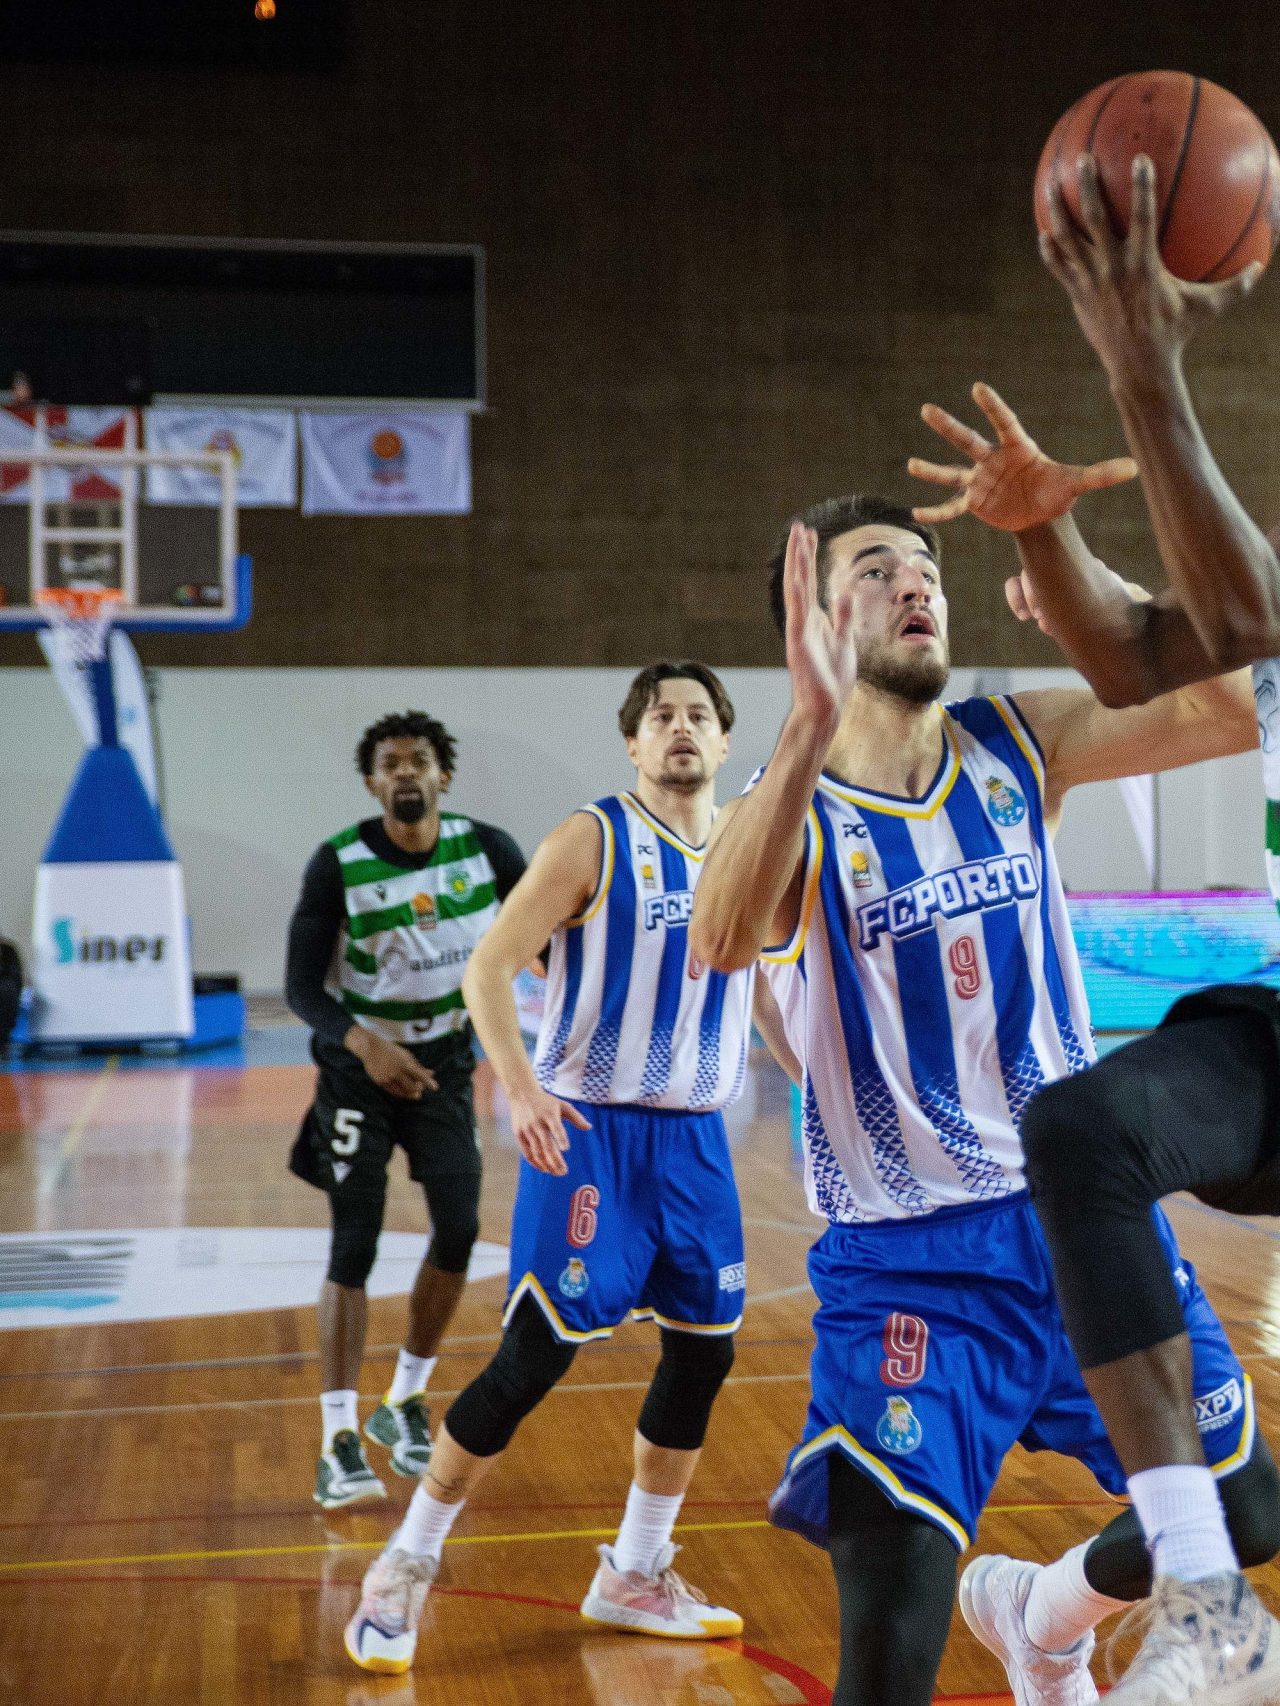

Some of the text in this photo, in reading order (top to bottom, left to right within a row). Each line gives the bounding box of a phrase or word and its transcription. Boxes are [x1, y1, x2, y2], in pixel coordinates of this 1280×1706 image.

[949, 935, 981, 1000] 9
[330, 1107, 365, 1156] 5
[566, 1184, 600, 1249] 6
[879, 1312, 928, 1388] 9
